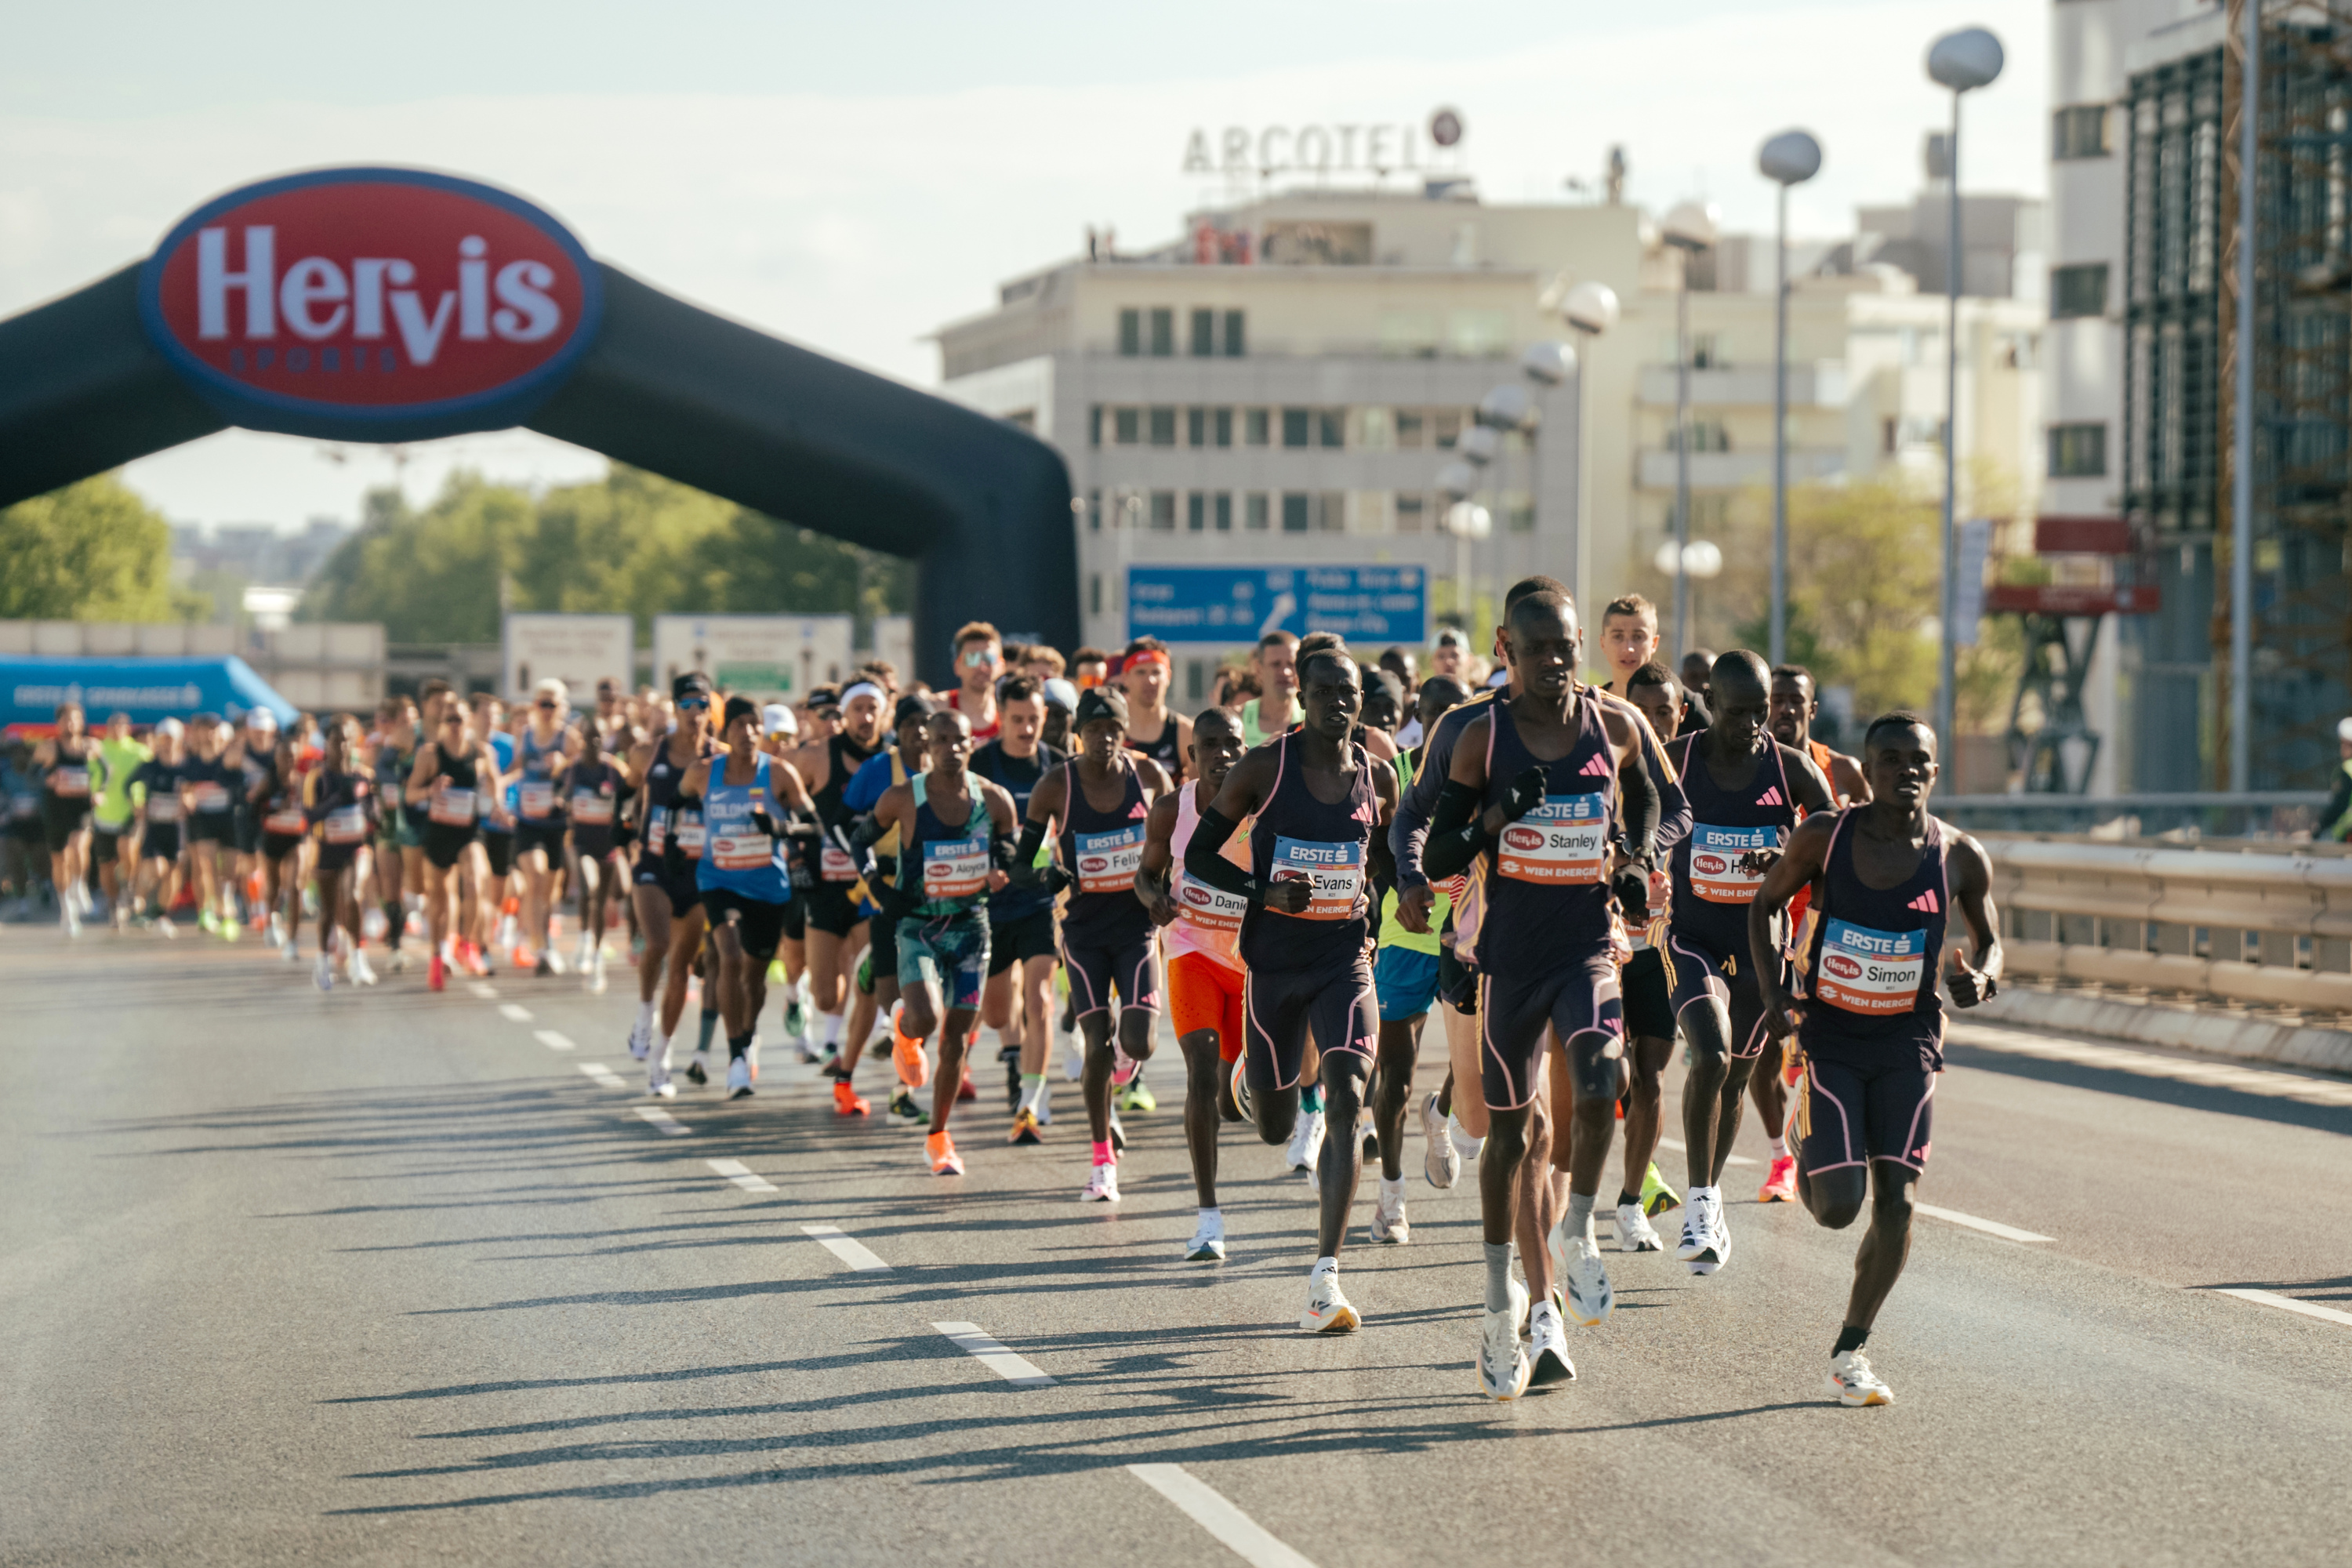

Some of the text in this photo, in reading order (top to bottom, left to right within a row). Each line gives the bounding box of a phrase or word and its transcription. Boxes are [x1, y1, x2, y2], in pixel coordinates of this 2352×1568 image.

[1182, 125, 1420, 171] ARCOTEL
[198, 224, 561, 366] Hervis
[230, 346, 397, 373] SPORTS
[1087, 834, 1122, 849] ERSTE
[1508, 831, 1597, 851] Hervis Stanley
[1706, 832, 1749, 847] ERSTE
[935, 844, 968, 856] ERSTE
[1290, 846, 1334, 862] ERSTE
[1113, 853, 1141, 868] Felix
[1697, 858, 1724, 871] Hervis
[1524, 866, 1598, 877] WIEN ENERGIE
[1313, 875, 1352, 890] Evans
[1185, 887, 1210, 902] Hervis
[1710, 887, 1735, 897] WIEN
[1316, 905, 1351, 914] ENERGIE
[1195, 915, 1217, 926] WIEN
[1842, 929, 1893, 953] ERSTE
[1827, 956, 1916, 982] Hervis Simon
[1841, 993, 1915, 1009] WIEN ENERGIE
